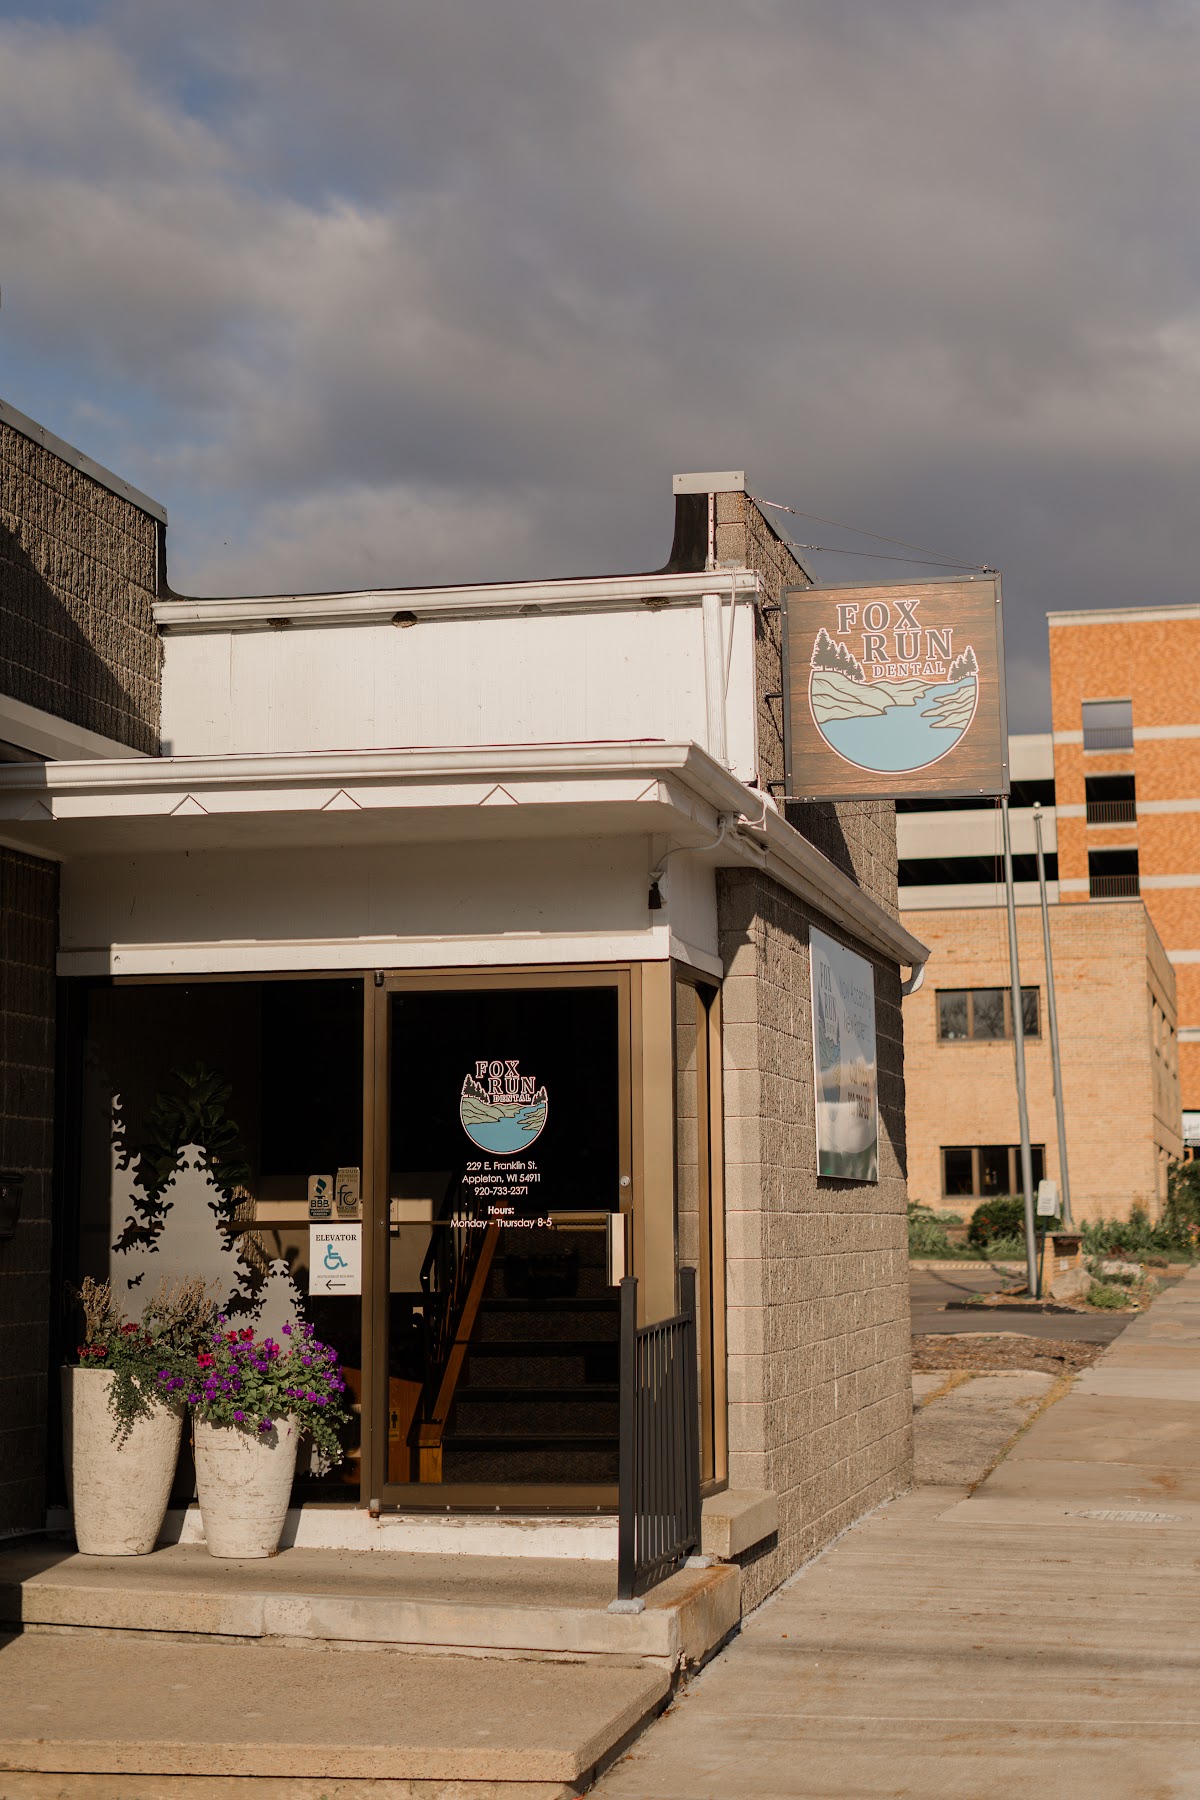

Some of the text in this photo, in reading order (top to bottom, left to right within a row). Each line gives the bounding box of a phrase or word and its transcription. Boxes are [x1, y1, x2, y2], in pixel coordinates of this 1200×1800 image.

[836, 600, 921, 634] FOX
[861, 629, 953, 663] RUN
[872, 661, 946, 678] DENTAL
[820, 962, 832, 992] FOX
[824, 992, 837, 1022] RUN
[475, 1060, 520, 1078] FOX
[487, 1077, 536, 1094] RUN
[492, 1094, 531, 1103] DENTAL
[466, 1161, 538, 1171] 229 E. Franklin St.
[461, 1173, 541, 1185] Appleton, WI 54911
[474, 1186, 528, 1196] 920-733-2371
[310, 1200, 329, 1208] BBB
[487, 1206, 515, 1215] Hours:
[450, 1219, 488, 1230] Monday
[496, 1218, 535, 1229] Thursday
[537, 1217, 553, 1227] 8-5
